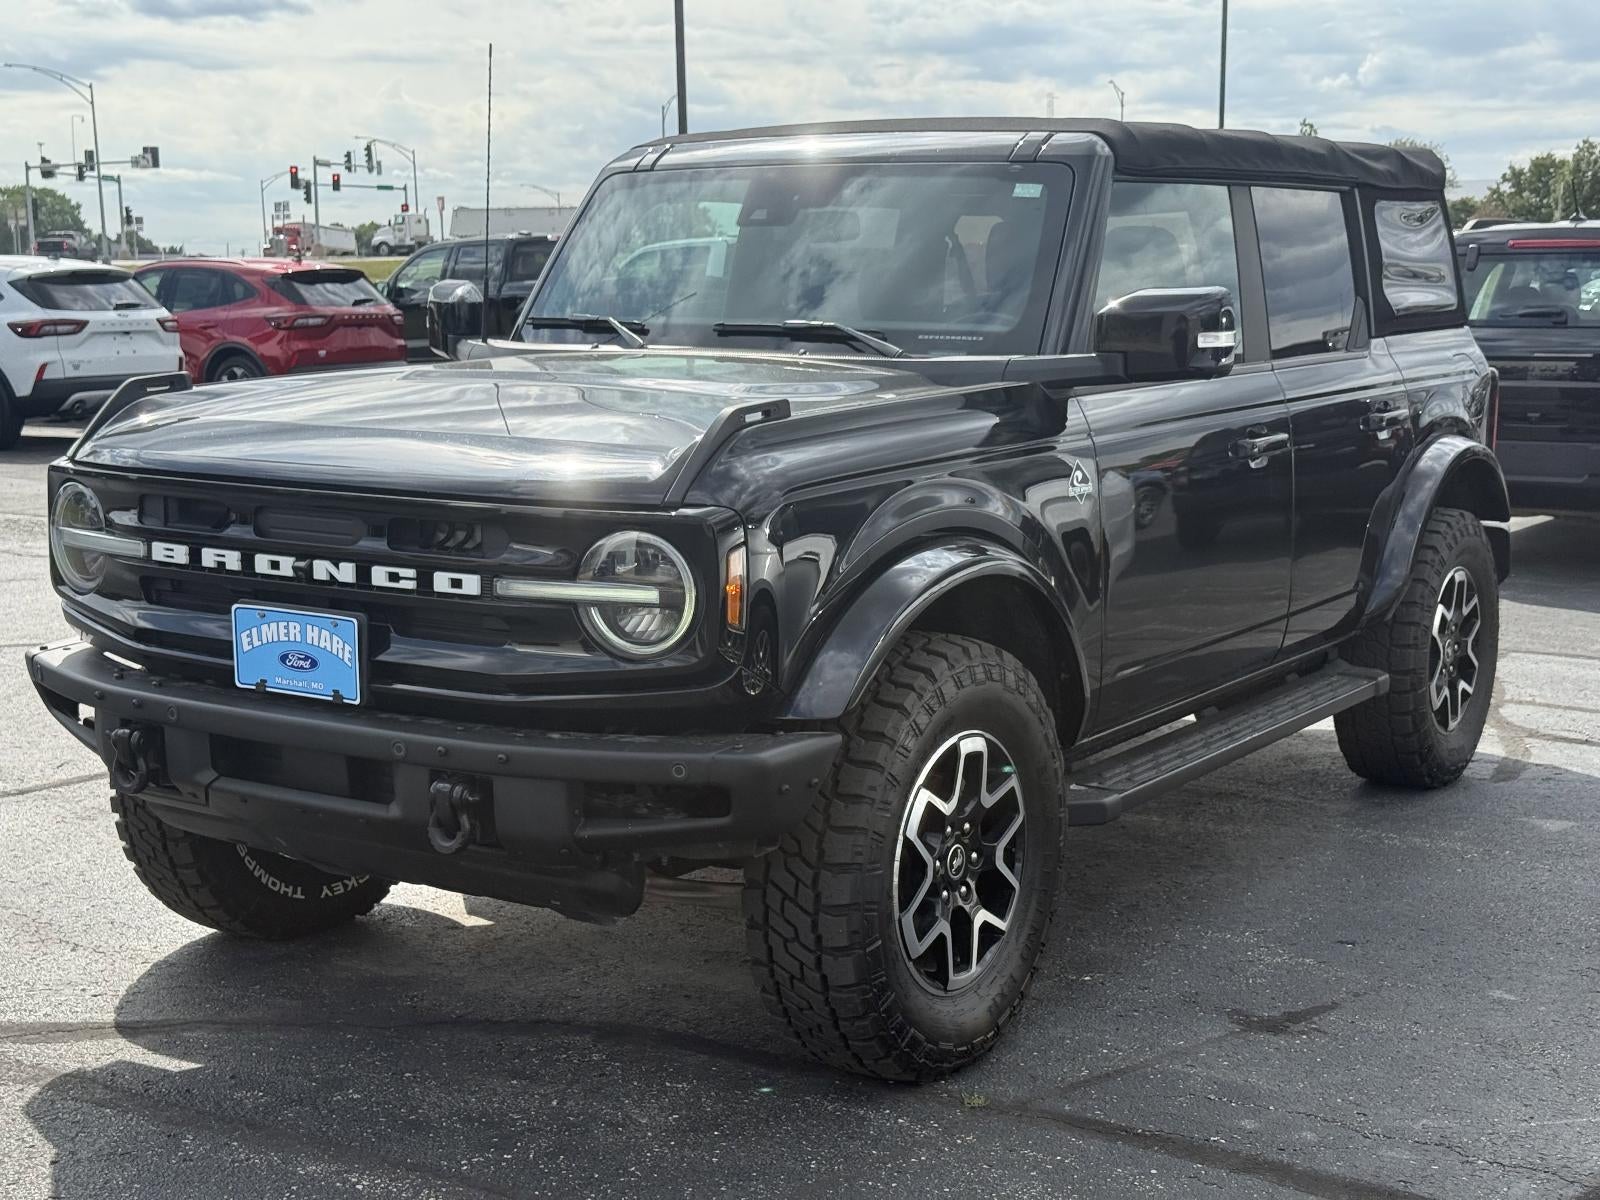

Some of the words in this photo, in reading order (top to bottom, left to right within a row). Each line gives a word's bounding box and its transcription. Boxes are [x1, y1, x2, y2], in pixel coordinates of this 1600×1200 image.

[151, 541, 481, 596] BRONCO
[240, 621, 302, 653] ELMER
[306, 623, 353, 668] HARE
[286, 652, 311, 669] Ford
[275, 677, 310, 688] Marshall,
[311, 682, 324, 690] MO
